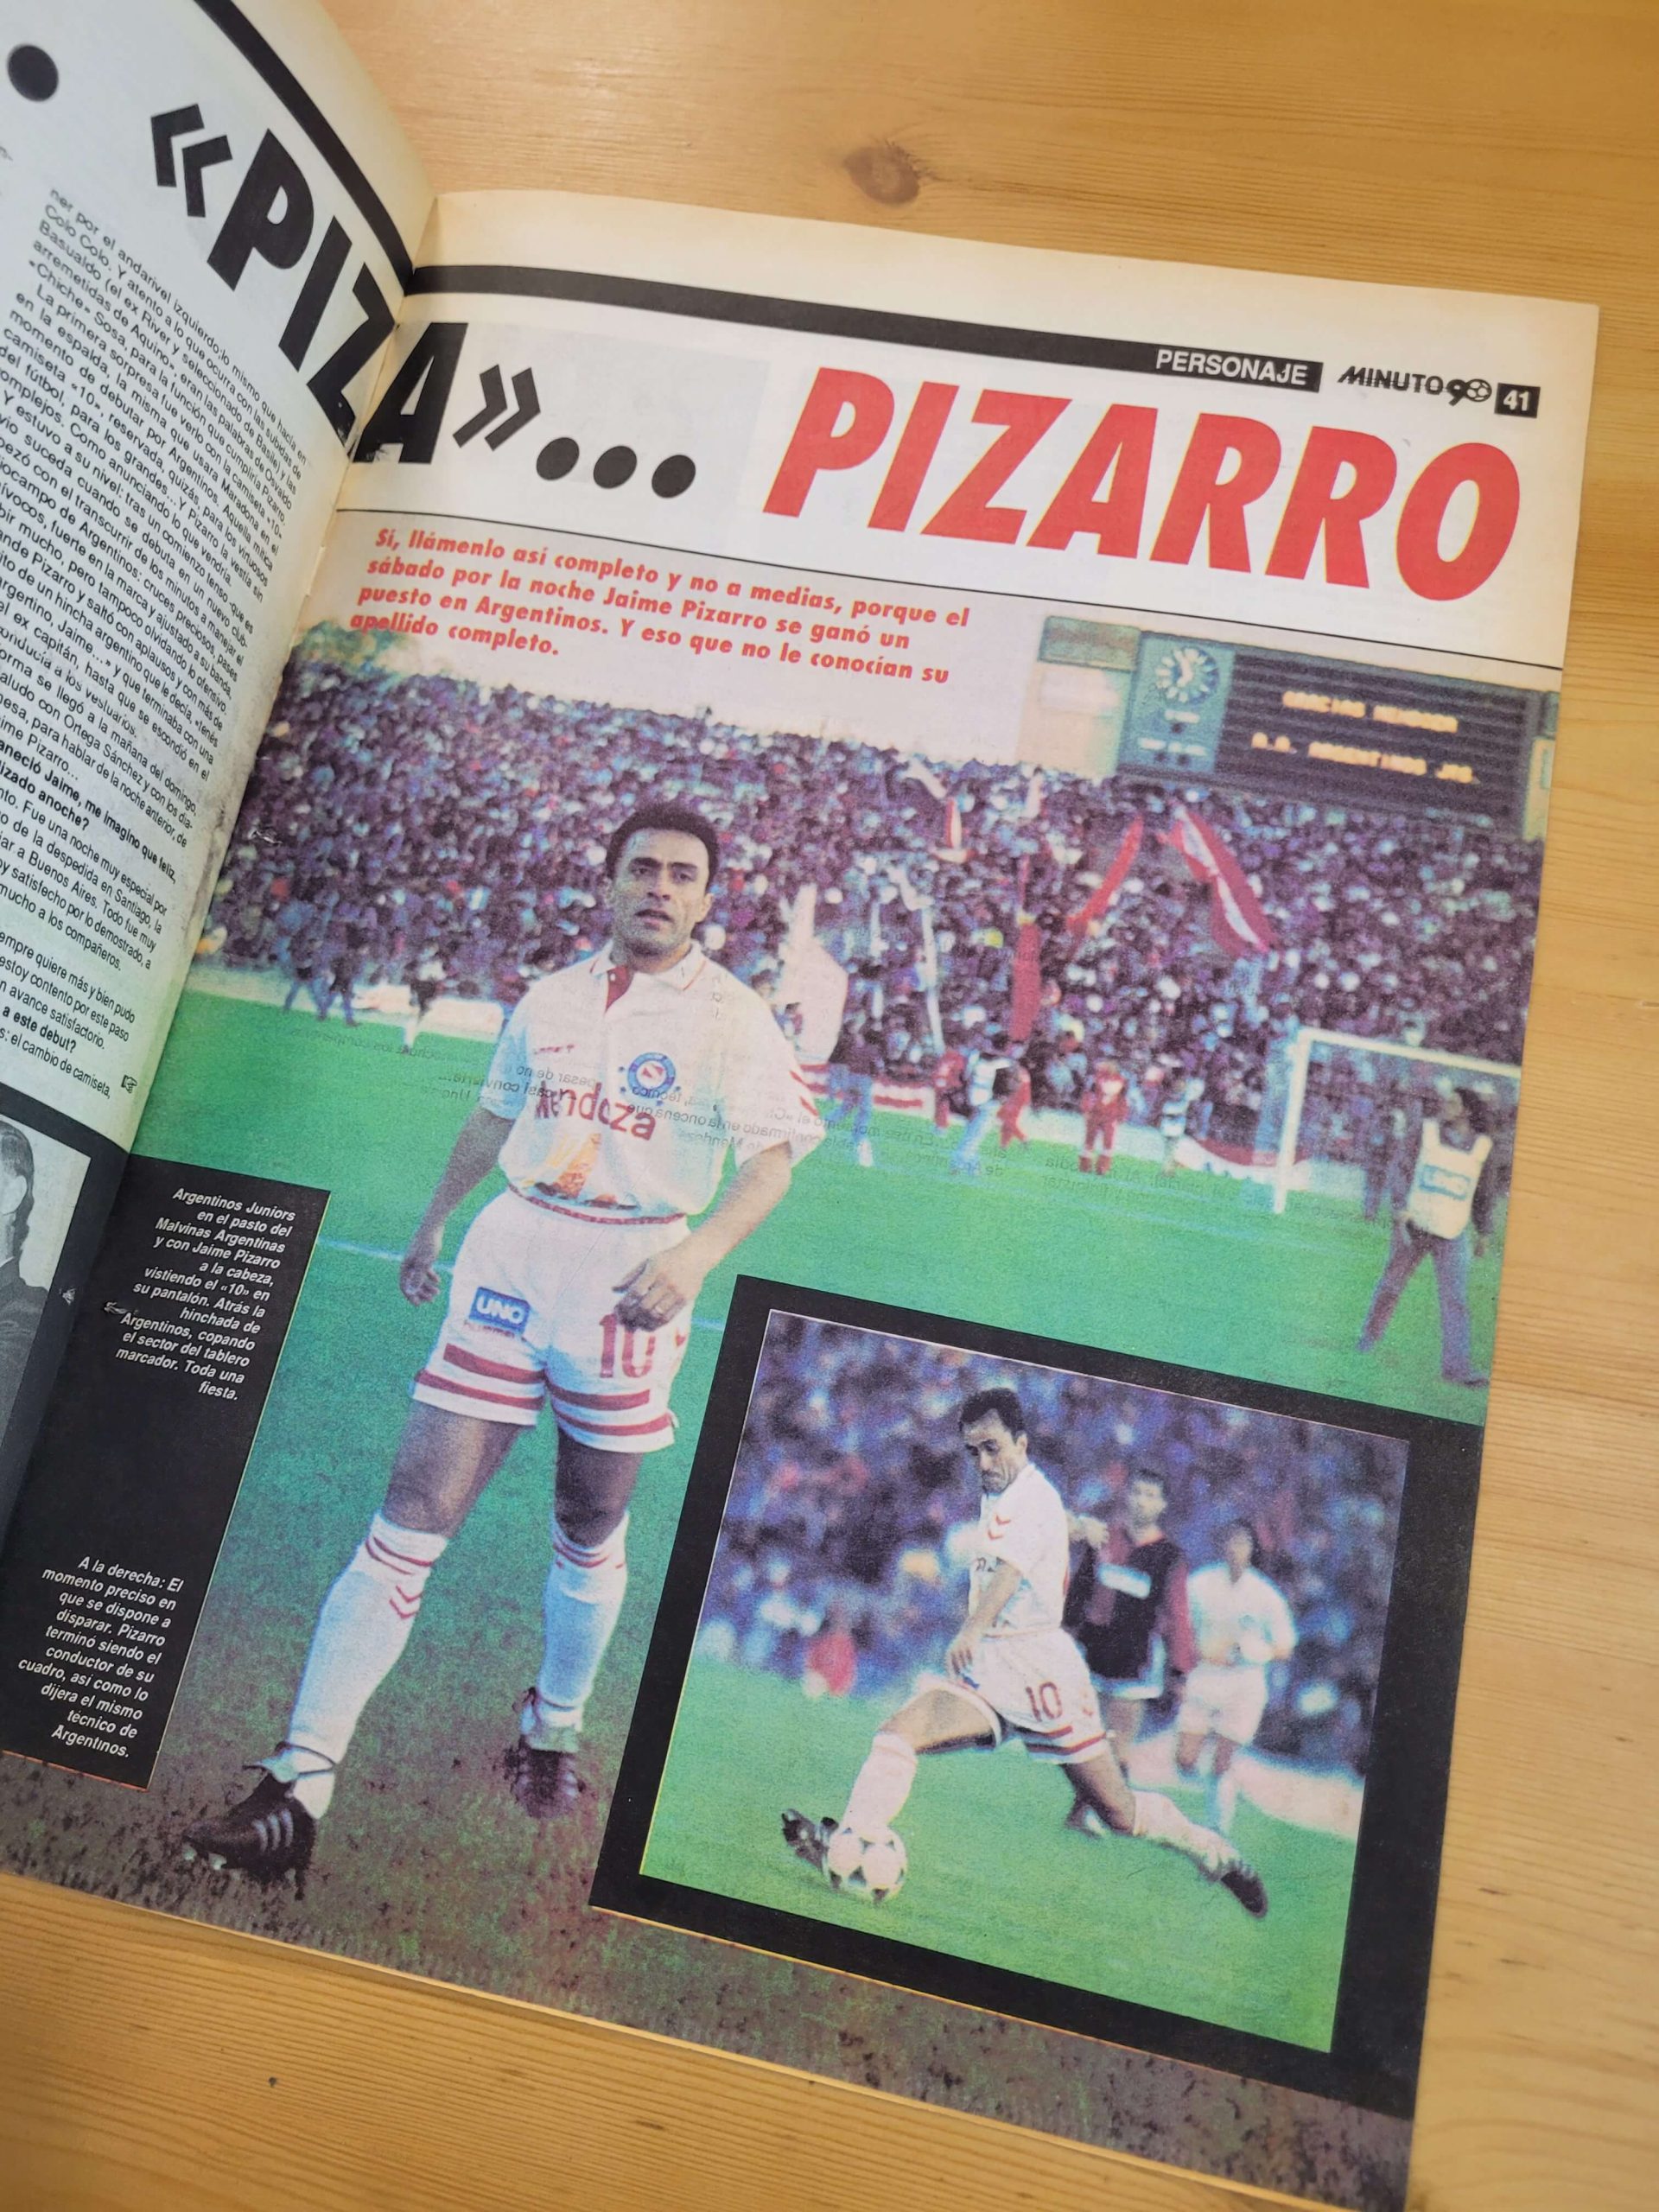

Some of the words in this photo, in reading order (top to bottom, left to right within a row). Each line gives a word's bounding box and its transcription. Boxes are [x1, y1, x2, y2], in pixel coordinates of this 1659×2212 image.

[75, 212, 99, 234] por
[103, 235, 116, 250] el
[118, 249, 171, 304] andarivel
[232, 365, 260, 402] mismo
[261, 400, 281, 423] que
[296, 449, 306, 465] en
[1155, 349, 1308, 385] PERSONAJE
[1503, 390, 1530, 412] 41
[762, 366, 1521, 601] PIZARRO
[407, 529, 505, 558] llámenlo
[512, 548, 546, 565] así
[553, 554, 658, 584] completo
[666, 572, 682, 591] y
[689, 575, 719, 593] no
[725, 582, 741, 596] a
[748, 585, 842, 614] medias,
[849, 599, 937, 626] porque
[944, 607, 969, 626] el
[367, 557, 445, 579] sábado
[450, 569, 491, 587] por
[499, 569, 521, 590] la
[528, 580, 594, 602] noche
[602, 587, 672, 615] Jaime
[680, 599, 767, 630] Pizarro
[775, 618, 802, 634] se
[810, 623, 870, 644] ganó
[879, 632, 909, 649] un
[346, 610, 438, 636] apellido
[448, 625, 558, 655] completo.
[357, 587, 431, 606] puesto
[438, 594, 467, 611] en
[474, 595, 608, 634] Argentinos.
[620, 617, 634, 637] Y
[640, 626, 681, 645] eso
[688, 634, 733, 655] que
[741, 642, 771, 659] no
[779, 640, 802, 664] le
[809, 652, 912, 679] conocían
[921, 666, 949, 683] su
[13, 613, 29, 630] ex
[33, 626, 79, 670] capitán,
[84, 661, 114, 695] hasta
[118, 691, 136, 712] que
[137, 709, 149, 725] se
[151, 722, 188, 760] escondió
[188, 758, 199, 772] en
[200, 769, 209, 781] el
[38, 790, 89, 830] anoche?
[44, 769, 81, 807] Jaime,
[85, 799, 101, 817] me
[103, 810, 140, 849] imagino
[142, 844, 162, 864] que
[22, 800, 46, 824] Fue
[48, 819, 68, 841] una
[69, 836, 99, 862] noche
[100, 858, 120, 880] muy
[120, 874, 155, 906] especial
[153, 899, 167, 916] por
[38, 908, 46, 919] a
[48, 910, 63, 931] los
[65, 925, 120, 970] compañeros.
[35, 953, 67, 979] quiere
[67, 973, 88, 993] más
[87, 986, 96, 1000] y
[95, 987, 114, 1009] bien
[113, 1003, 135, 1023] pudo
[2, 1006, 10, 1017] a
[13, 1012, 37, 1032] este
[39, 1024, 76, 1053] debut?
[9, 986, 48, 1014] avance
[49, 1008, 104, 1049] satisfactorio.
[10, 1033, 22, 1047] el
[22, 1039, 59, 1066] cambio
[59, 1058, 72, 1074] de
[73, 1067, 110, 1099] camiseta,
[172, 1187, 243, 1211] Argentinos
[245, 1202, 296, 1221] Juniors
[155, 1217, 212, 1238] Malvinas
[213, 1229, 285, 1253] Argentinas
[196, 1211, 213, 1222] en
[215, 1213, 230, 1224] el
[228, 1217, 267, 1232] pasto
[270, 1223, 293, 1236] del
[153, 1236, 164, 1248] y
[165, 1238, 190, 1250] con
[192, 1241, 232, 1259] Jaime
[233, 1249, 281, 1268] Pizarro
[144, 1266, 201, 1287] vistiendo
[204, 1279, 219, 1290] el
[220, 1283, 249, 1295] «10»
[252, 1290, 270, 1301] en
[199, 1262, 208, 1271] a
[210, 1262, 224, 1274] la
[226, 1268, 273, 1287] cabeza,
[133, 1283, 150, 1294] su
[149, 1287, 209, 1306] pantalón.
[213, 1297, 250, 1314] Atrás
[251, 1305, 265, 1317] la
[476, 1296, 524, 1325] UNO
[120, 1313, 192, 1339] Argentinos,
[197, 1331, 255, 1351] copando
[179, 1306, 240, 1329] hinchada
[243, 1320, 260, 1333] de
[115, 1348, 178, 1370] marcador.
[184, 1359, 216, 1377] Toda
[219, 1370, 245, 1383] una
[122, 1332, 137, 1343] el
[137, 1335, 179, 1351] sector
[180, 1342, 202, 1356] del
[203, 1347, 250, 1367] tablero
[198, 1381, 238, 1400] fiesta.
[41, 1569, 104, 1592] momento
[104, 1585, 156, 1605] preciso
[158, 1598, 176, 1610] en
[78, 1556, 90, 1569] A
[92, 1559, 105, 1573] la
[106, 1563, 165, 1588] derecha:
[166, 1577, 184, 1592] El
[56, 1608, 111, 1634] disparar.
[117, 1623, 165, 1646] Pizarro
[59, 1592, 84, 1605] que
[86, 1599, 103, 1611] se
[105, 1601, 159, 1624] dispone
[161, 1618, 171, 1628] a
[45, 1625, 96, 1648] terminó
[98, 1639, 143, 1661] siendo
[146, 1652, 162, 1664] el
[17, 1659, 66, 1681] cuadro,
[92, 1679, 131, 1697] como
[133, 1687, 149, 1701] lo
[45, 1647, 114, 1672] conductor
[116, 1662, 134, 1677] de
[136, 1670, 155, 1682] su
[41, 1682, 78, 1702] dijera
[80, 1694, 95, 1707] el
[95, 1700, 143, 1719] mismo
[1025, 1681, 1063, 1722] 10
[51, 1725, 129, 1758] Argentinos.
[67, 1709, 116, 1732] técnico
[119, 1723, 137, 1738] de
